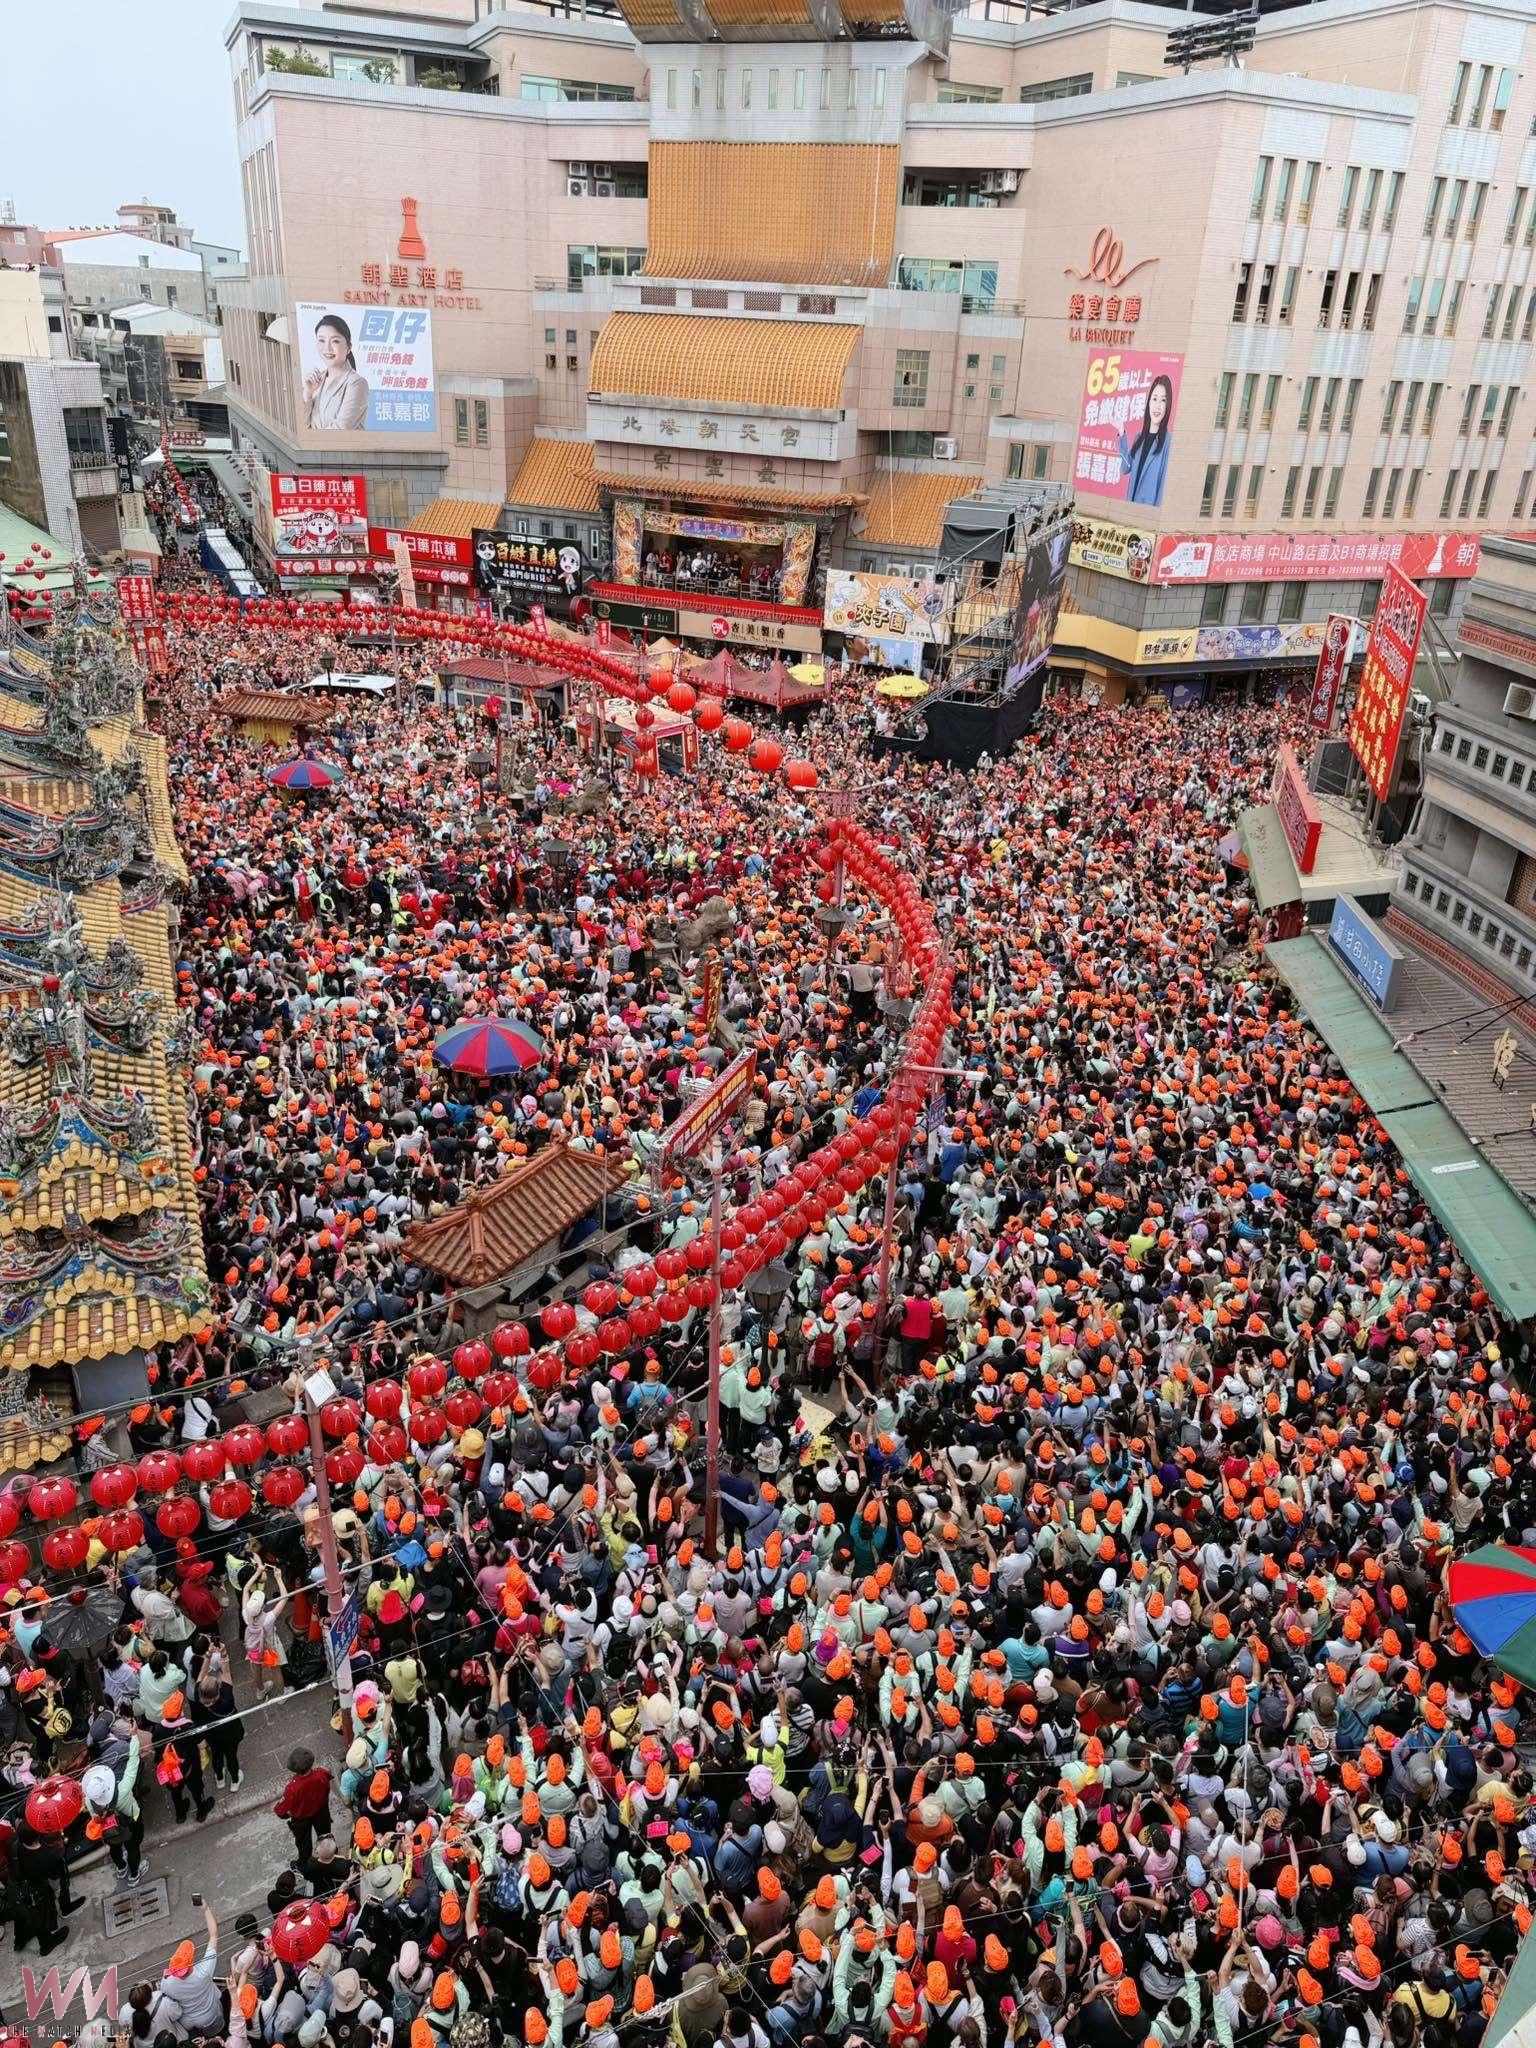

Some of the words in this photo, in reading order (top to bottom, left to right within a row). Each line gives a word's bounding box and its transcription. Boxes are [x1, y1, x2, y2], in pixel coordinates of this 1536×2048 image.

[361, 263, 464, 291] 朝聖酒店
[343, 289, 392, 305] SAINT
[397, 294, 428, 307] ART
[434, 296, 483, 311] HOTEL
[375, 402, 431, 423] 張嘉郡
[1213, 544, 1265, 563] 飯店商場
[1456, 543, 1481, 567] 朝
